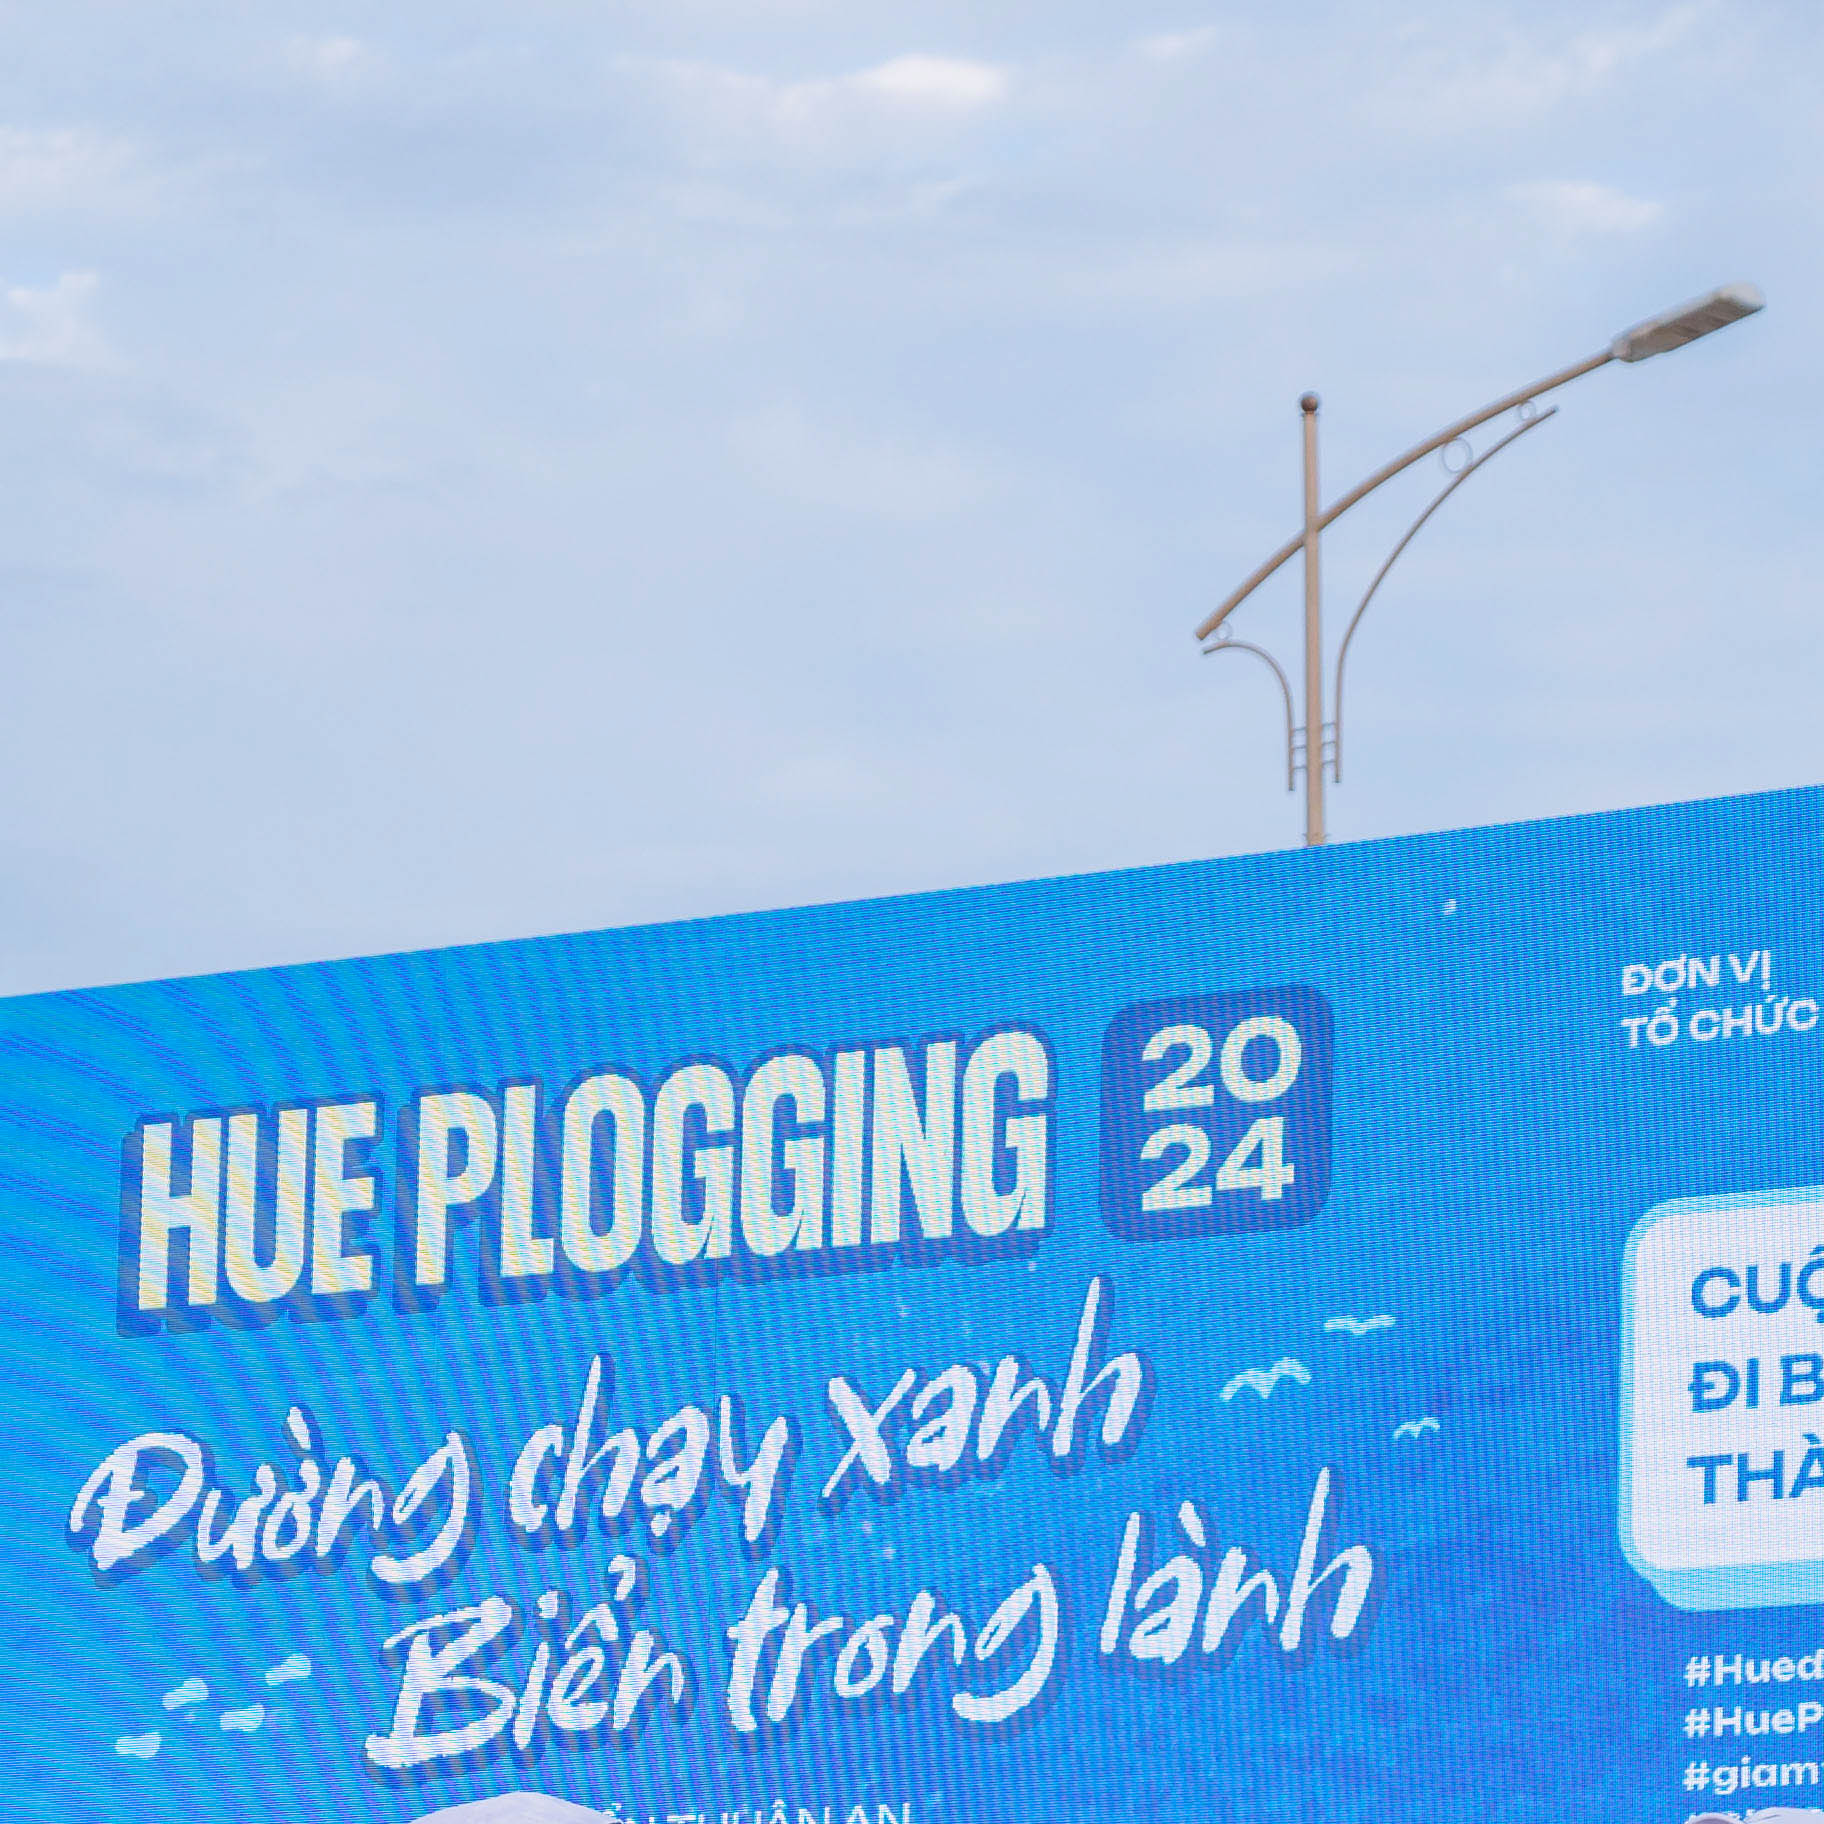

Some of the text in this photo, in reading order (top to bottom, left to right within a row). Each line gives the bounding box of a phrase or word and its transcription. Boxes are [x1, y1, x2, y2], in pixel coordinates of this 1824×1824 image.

[1622, 949, 1771, 995] ĐƠN VỊ
[1142, 1016, 1302, 1112] 20
[1620, 994, 1819, 1049] TỔ CHỨC
[138, 1030, 1049, 1312] HUE PLOGGING
[1140, 1116, 1295, 1212] 24
[69, 1275, 1143, 1584] Đường chạy xanh
[1687, 1357, 1760, 1414] ĐI
[365, 1466, 1374, 1768] Biển trong lành
